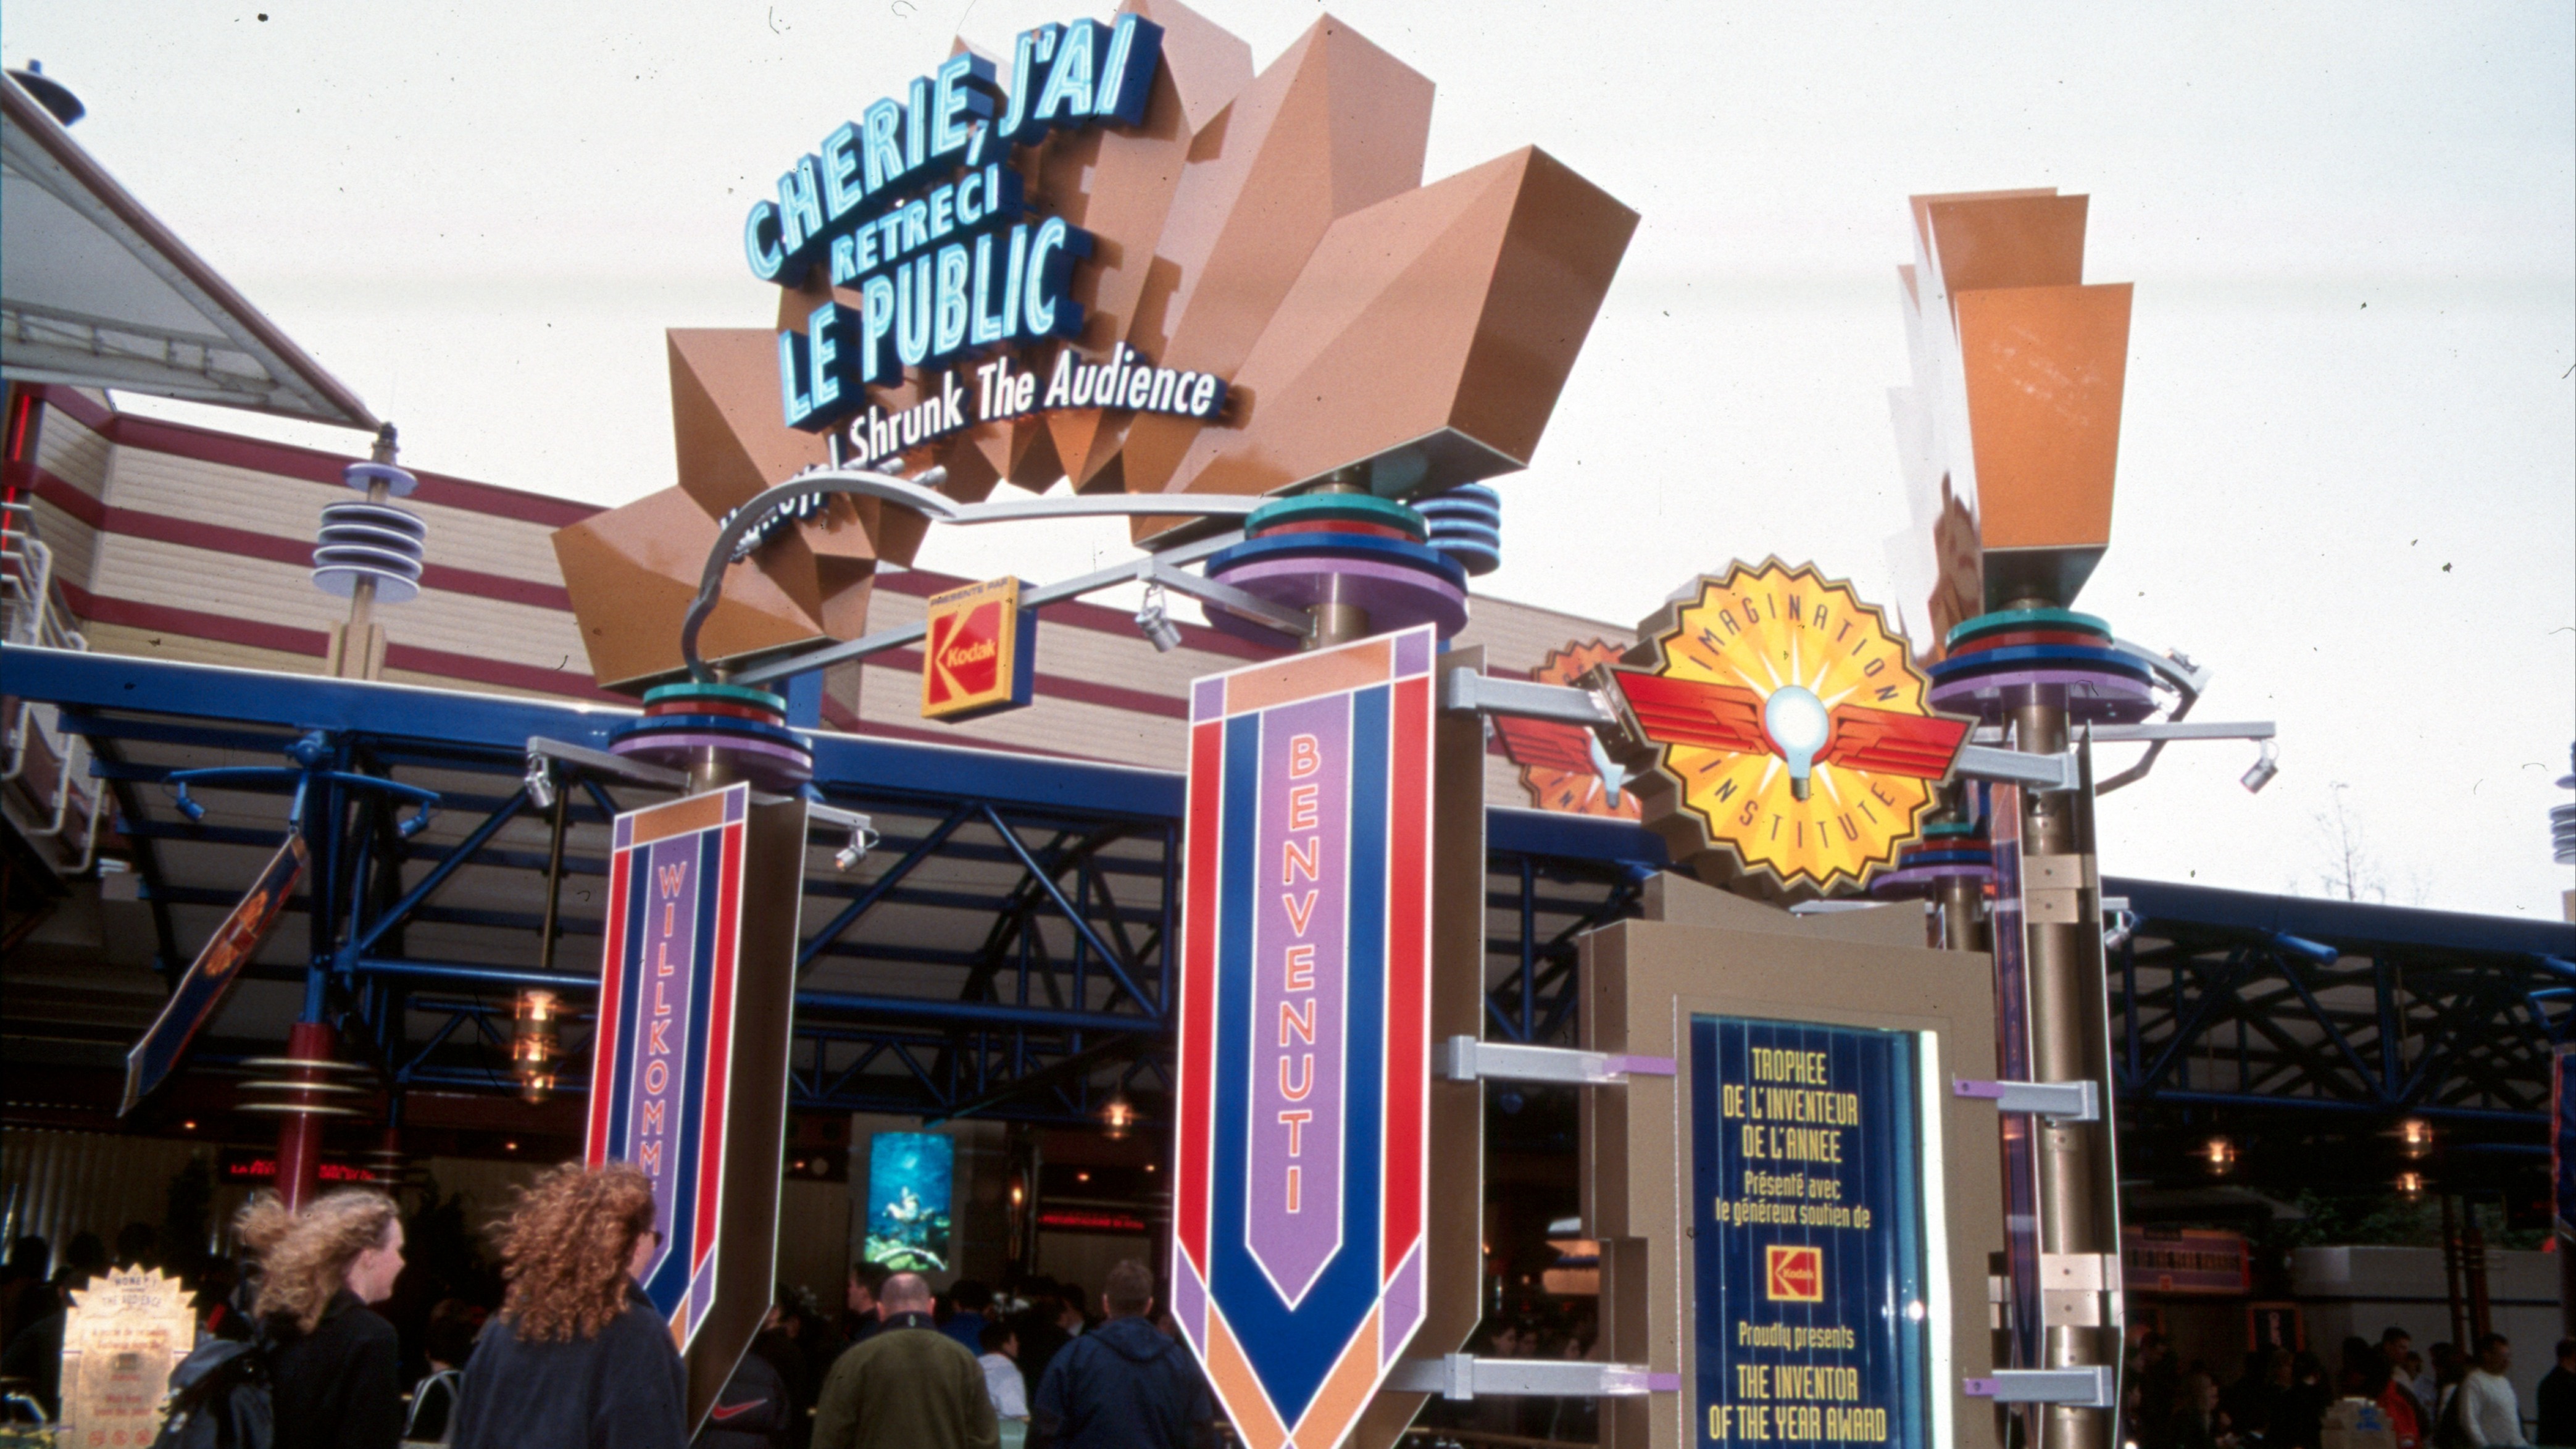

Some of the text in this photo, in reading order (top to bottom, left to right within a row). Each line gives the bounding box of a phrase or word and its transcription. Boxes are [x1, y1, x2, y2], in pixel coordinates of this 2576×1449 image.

[744, 13, 1136, 281] CHERIE, J'AI
[832, 164, 999, 286] RETRECI
[779, 217, 1066, 428] LE PUBLIC
[851, 372, 964, 463] Shrunk
[977, 356, 1034, 420] The
[1044, 343, 1216, 416] Audience
[946, 638, 996, 668] Kodak
[1690, 593, 1899, 703] IMAGINATION
[1699, 759, 1894, 849] INSTITUTE
[1278, 735, 1322, 1214] BENVENUTI
[640, 861, 687, 1191] WILLKOMM
[1752, 1048, 1827, 1085] TROPHEE
[1723, 1085, 1858, 1126] DE L'INVENTEUR
[1742, 1125, 1842, 1163] DE L'ANNEE
[1744, 1171, 1841, 1200] Présenté avec
[1716, 1198, 1870, 1229] le généreux soutien de
[1782, 1268, 1814, 1280] Kodak
[1739, 1321, 1855, 1351] Proudly presents
[1737, 1364, 1858, 1401] THE INVENTOR
[1709, 1405, 1886, 1442] OF THE YEAR AWARD
